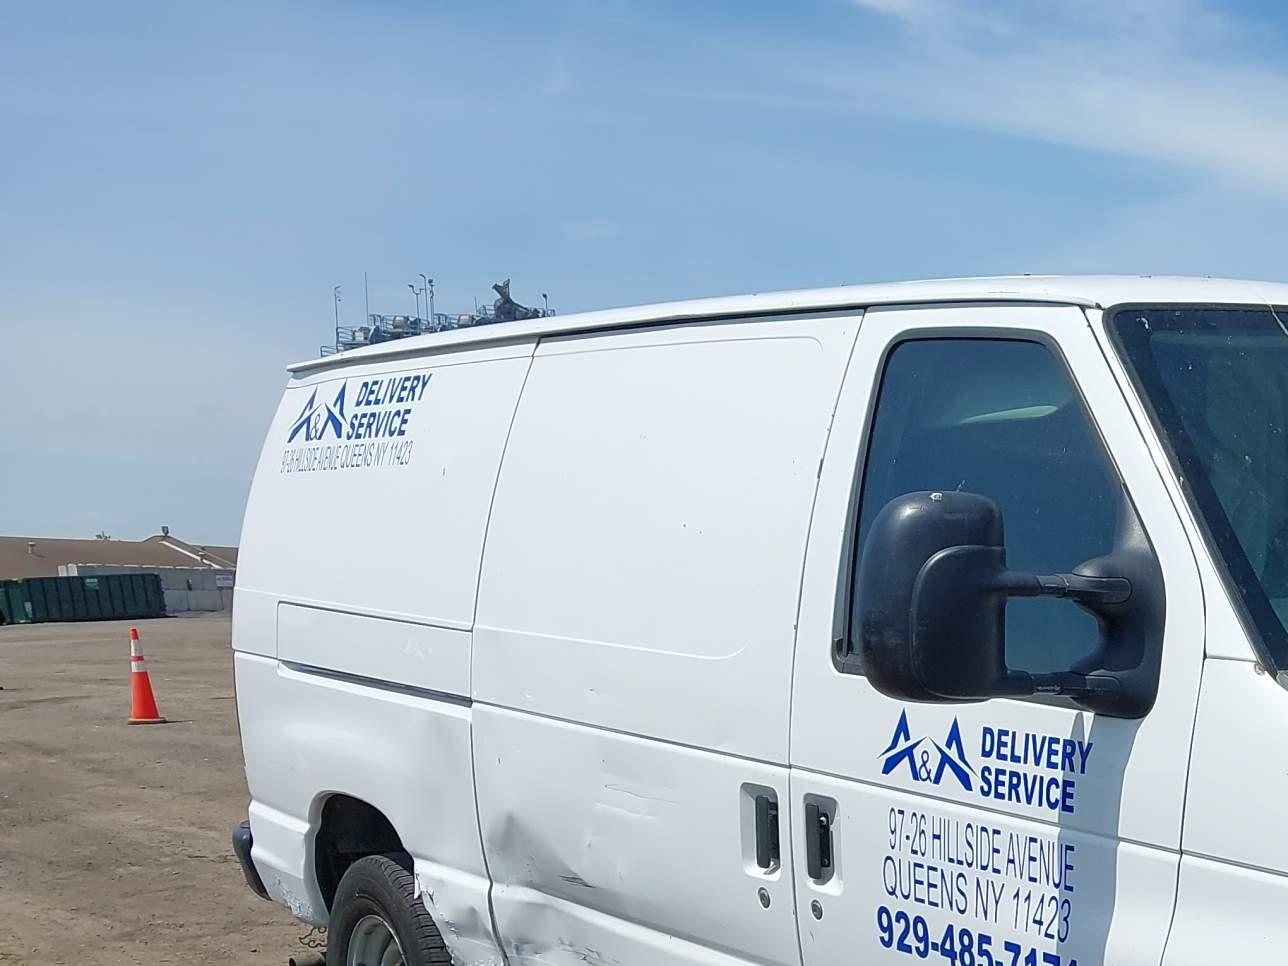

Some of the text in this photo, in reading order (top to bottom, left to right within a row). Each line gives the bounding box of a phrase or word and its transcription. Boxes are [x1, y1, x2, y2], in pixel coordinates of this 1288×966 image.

[287, 378, 348, 443] A&A
[355, 373, 432, 407] DELIVERY
[346, 409, 412, 440] SERVICE
[340, 442, 375, 468] QUEENS
[374, 441, 390, 466] NY
[389, 439, 414, 465] 11423
[877, 706, 979, 791] A&A
[981, 726, 1094, 775] DELIVERY
[979, 765, 1076, 813] SERVICE
[889, 807, 1075, 892] 97-26 HILLSIDE AVENUE
[882, 855, 1072, 943] QUEENS NY 11423
